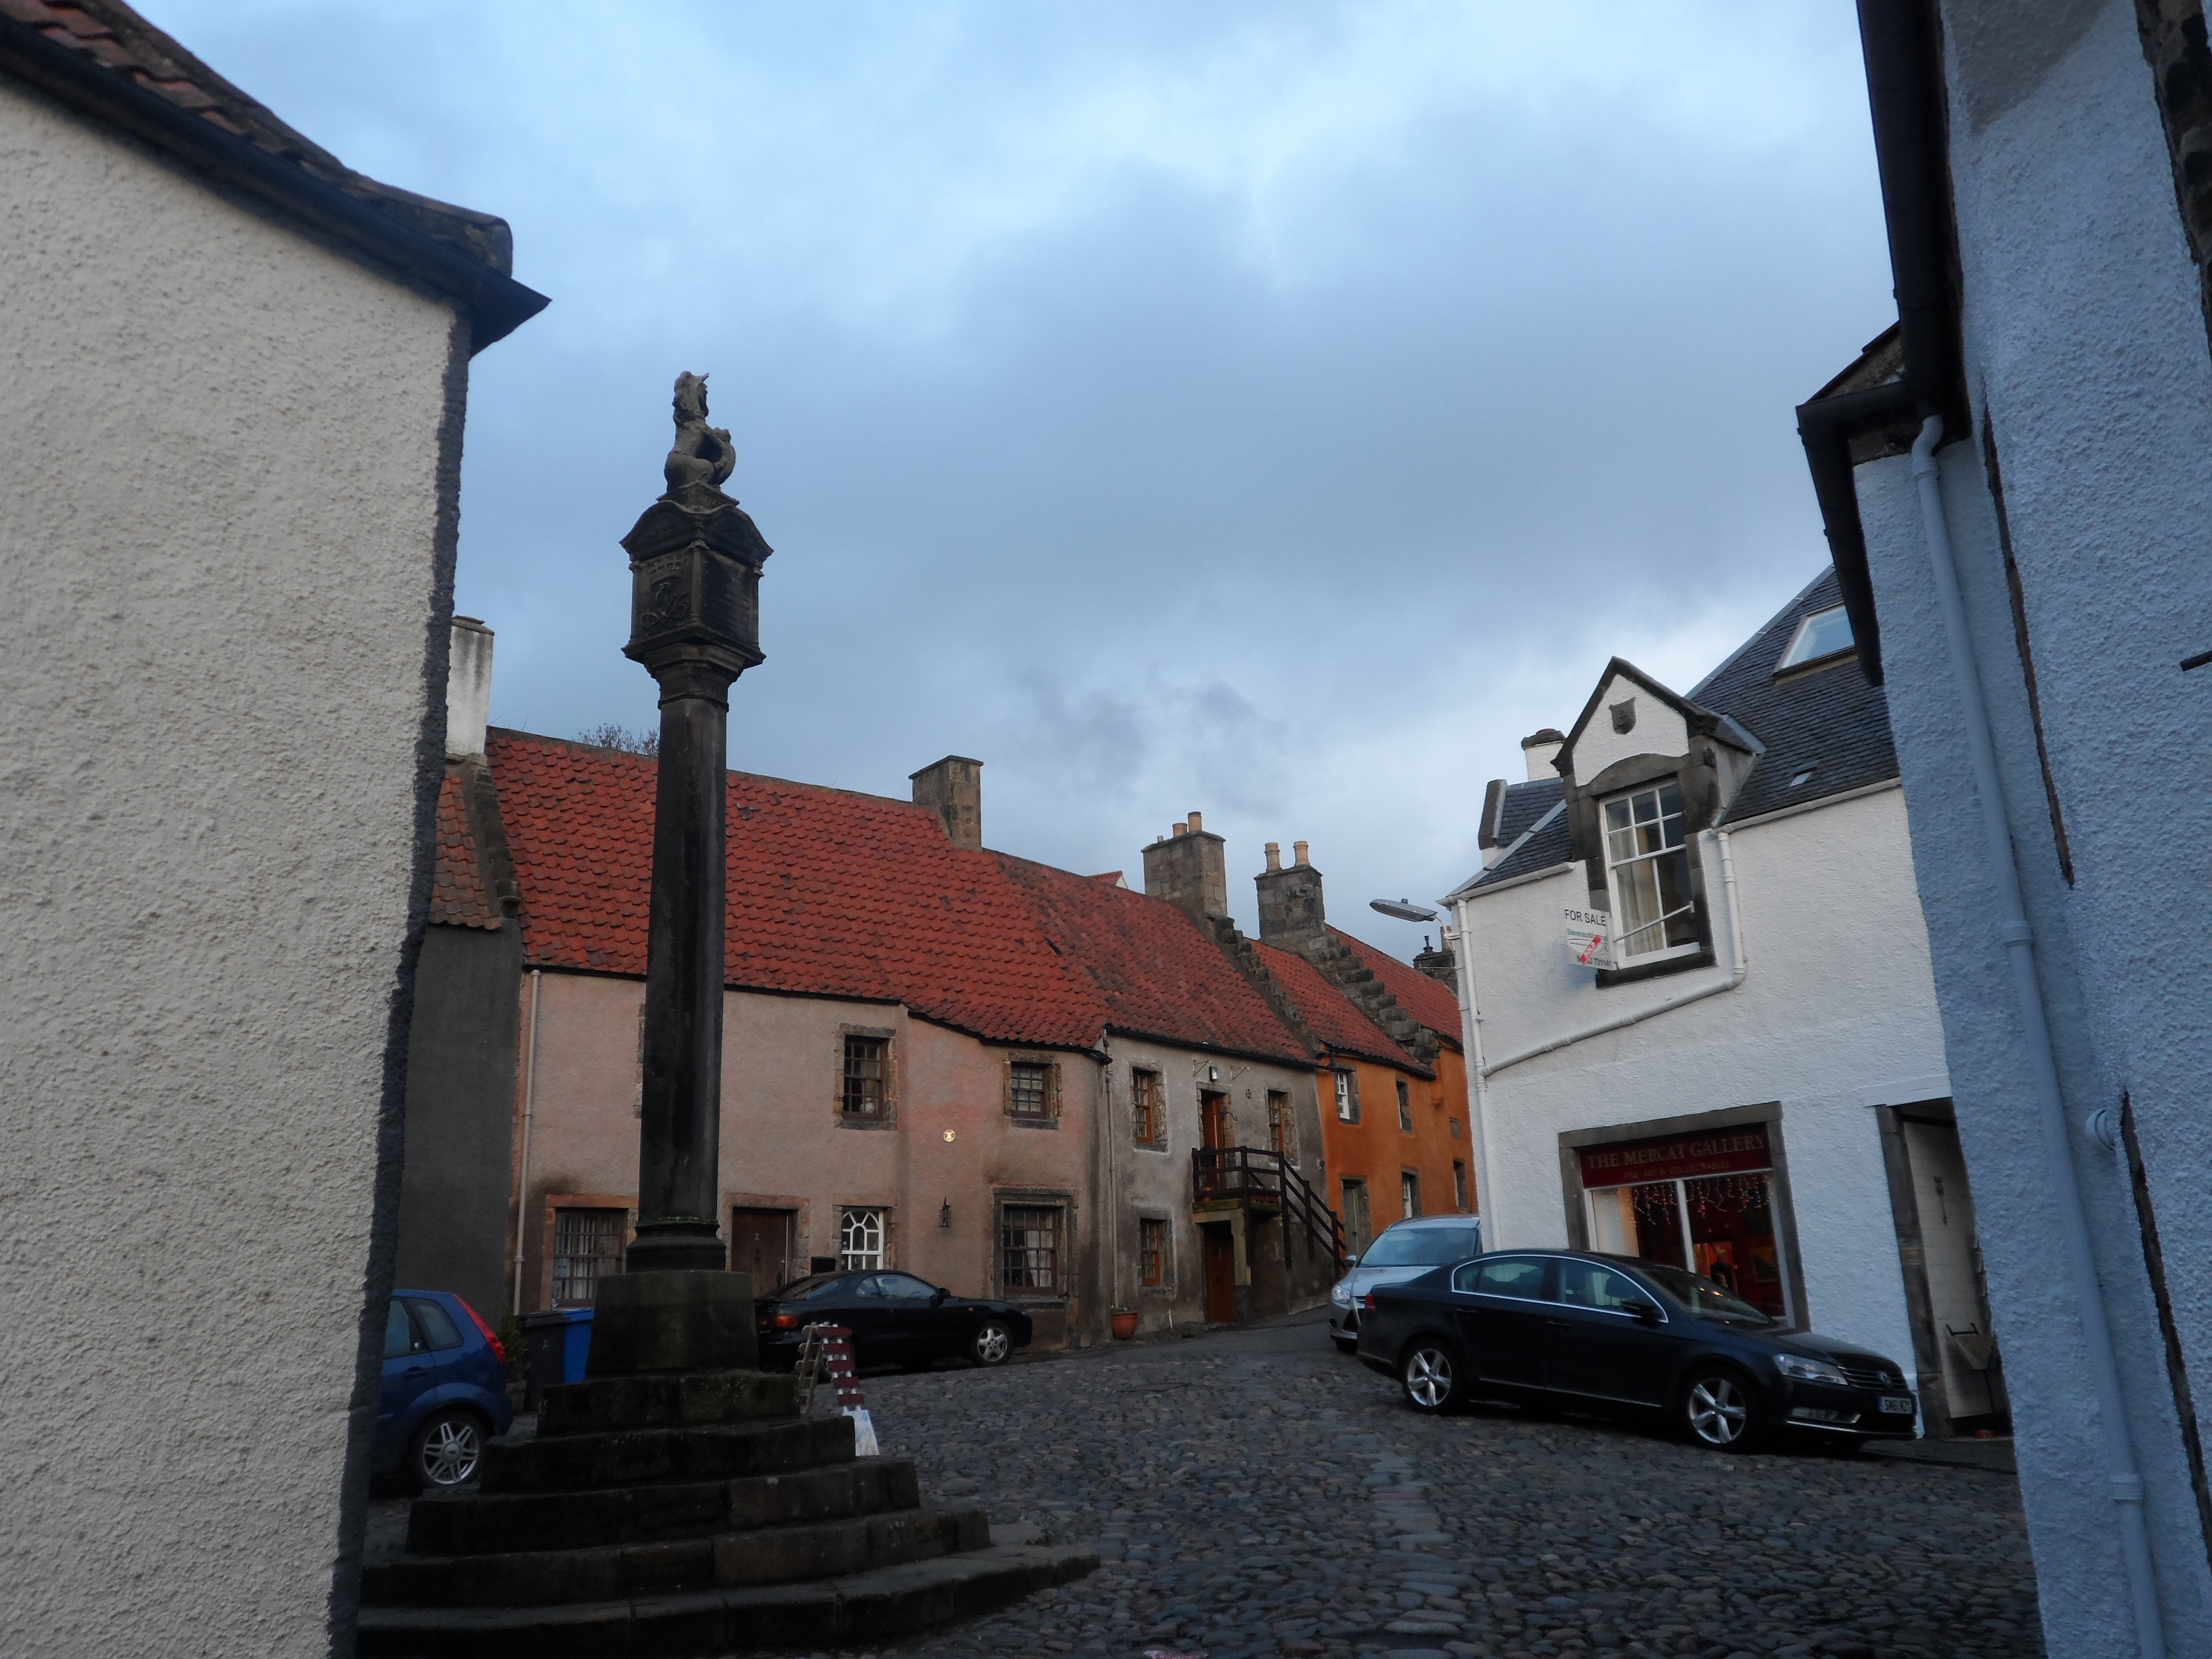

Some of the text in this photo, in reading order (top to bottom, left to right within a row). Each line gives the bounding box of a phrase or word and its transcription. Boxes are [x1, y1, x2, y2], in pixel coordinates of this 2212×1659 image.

[1564, 909, 1606, 926] FOR SALE
[1584, 942, 1596, 958] SOLD
[1587, 1134, 1767, 1169] THE MERCAT GALLERY
[1623, 1171, 1639, 1180] FINE
[1644, 1169, 1657, 1177] ART
[1670, 1160, 1730, 1175] COLLECTABLES
[542, 1339, 549, 1349] 2
